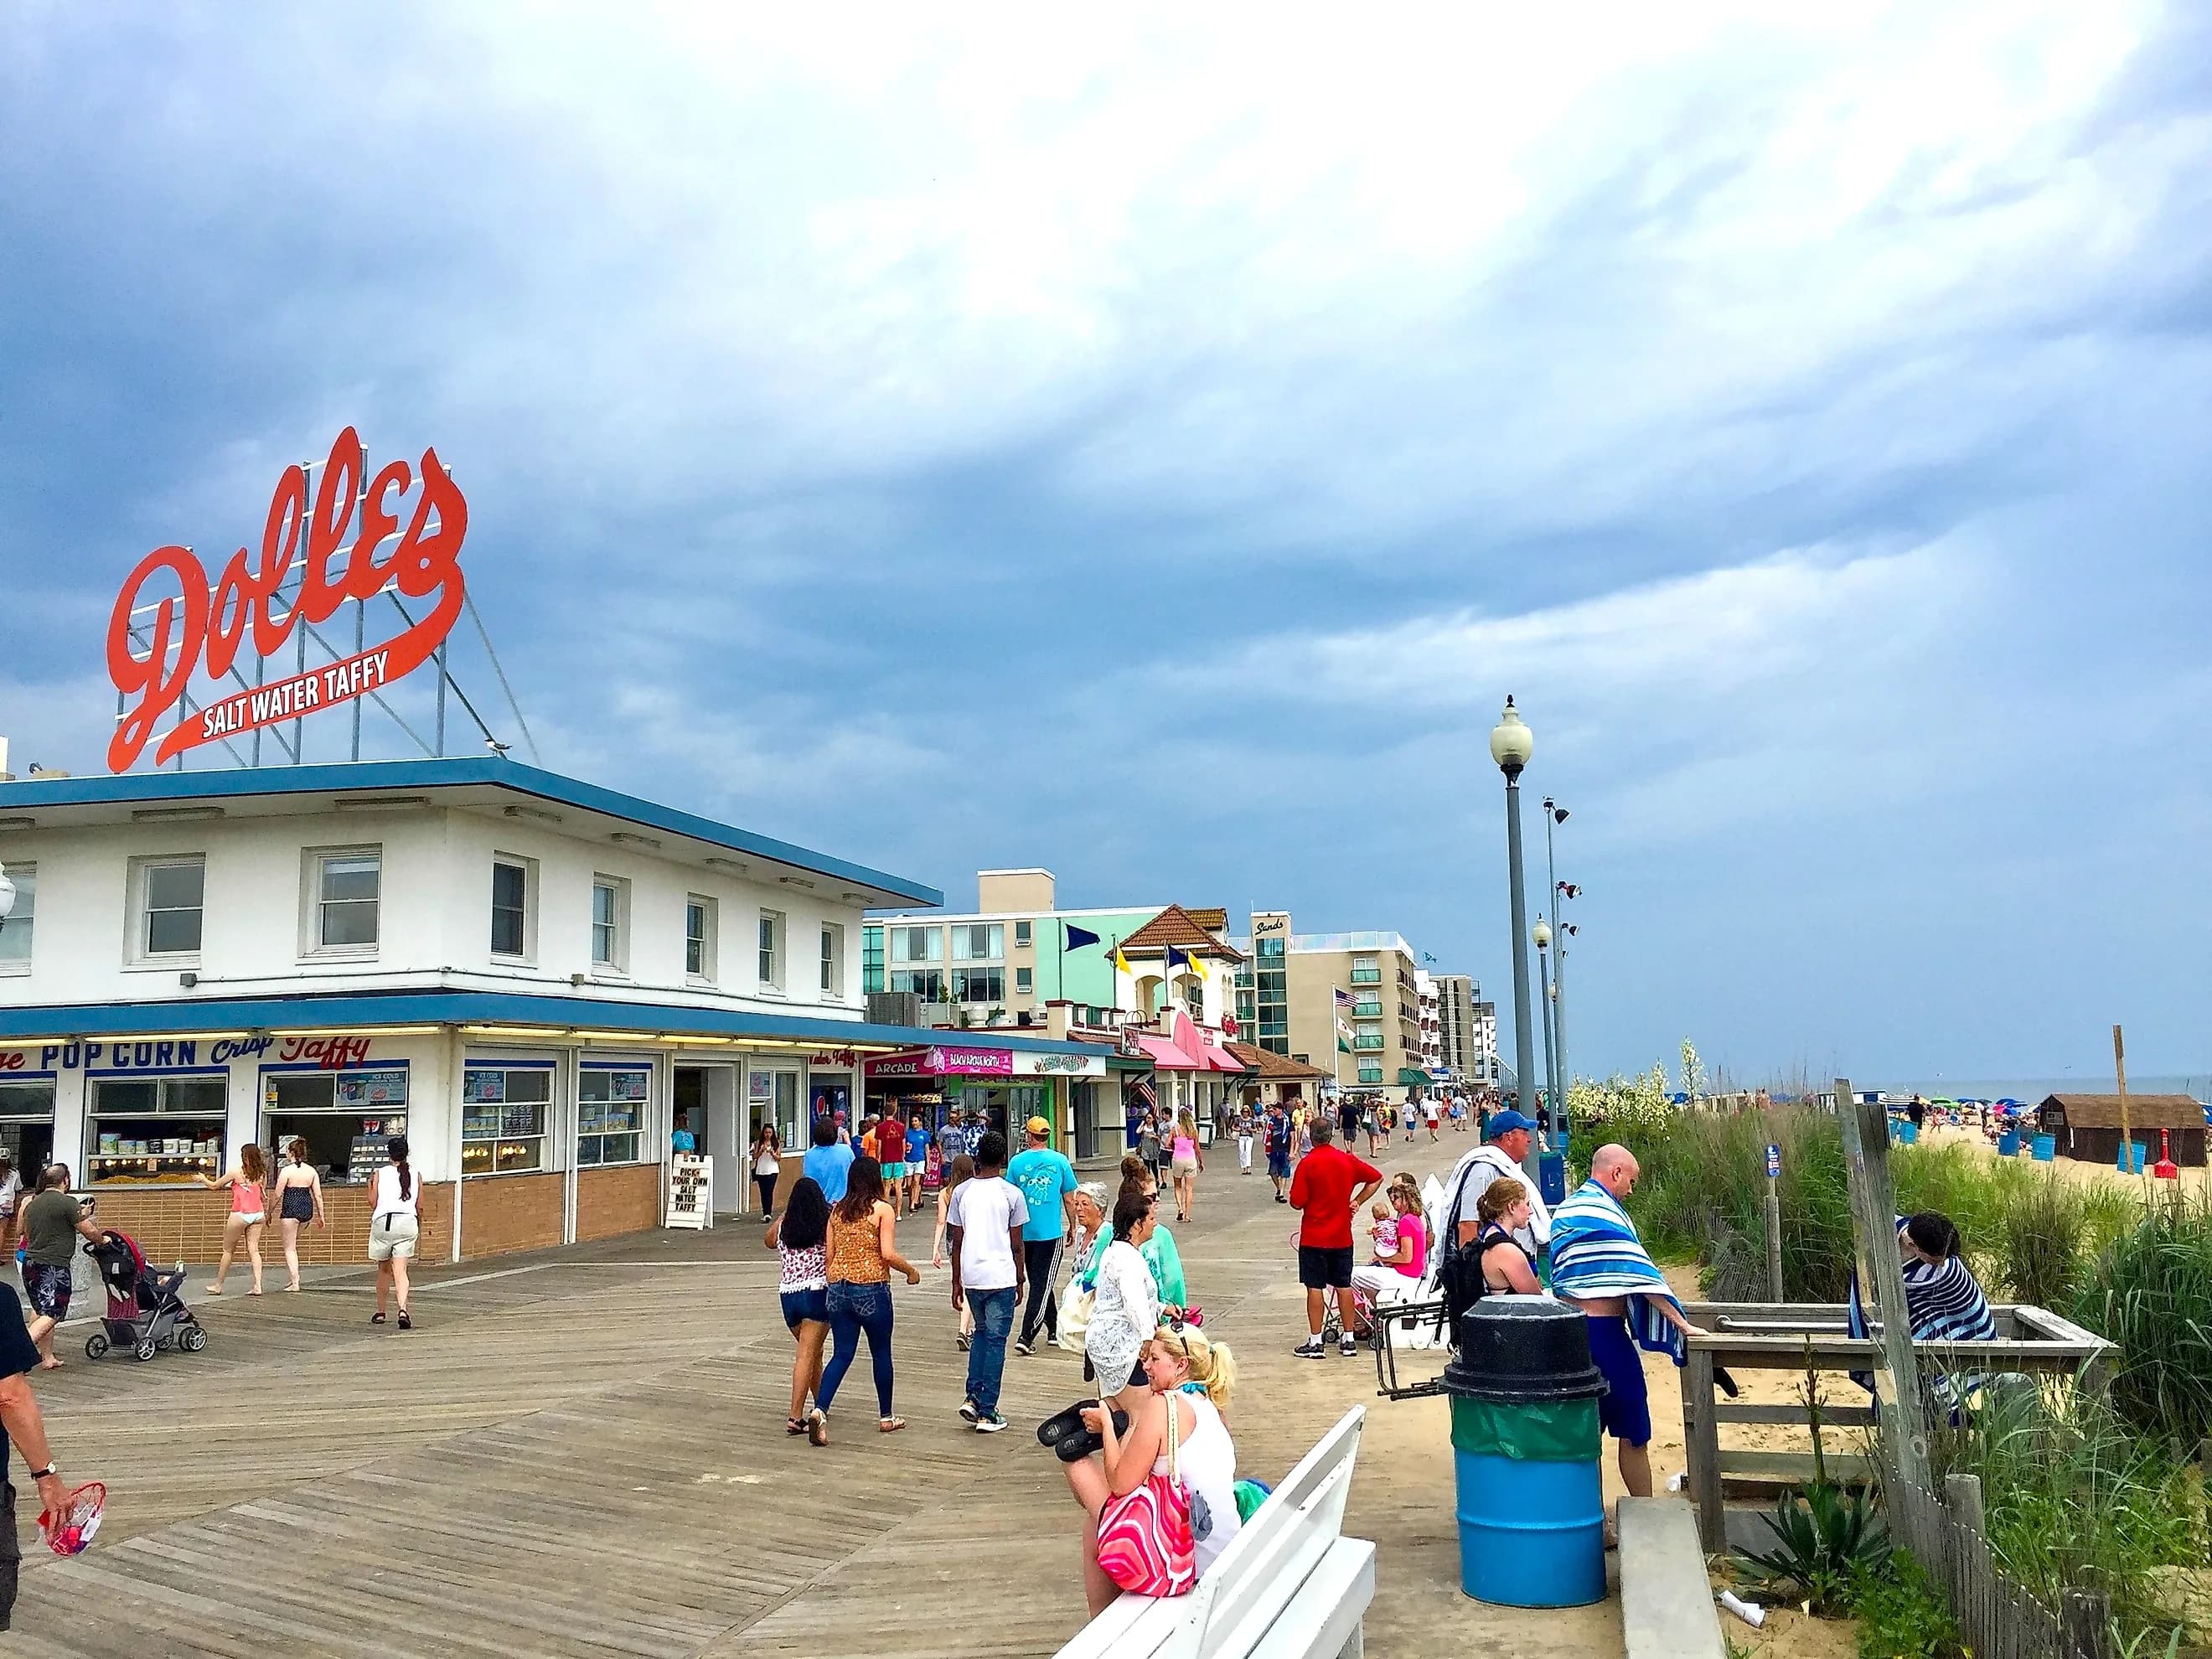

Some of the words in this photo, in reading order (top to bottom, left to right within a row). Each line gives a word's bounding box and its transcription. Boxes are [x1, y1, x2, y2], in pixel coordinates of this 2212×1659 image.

[202, 696, 248, 739] SALT
[251, 675, 320, 725] WATER
[323, 649, 390, 702] TAFFY
[1254, 918, 1284, 935] Sands
[41, 1041, 102, 1069] POP
[112, 1040, 197, 1067] CORN
[279, 1035, 371, 1070] Taffy
[875, 1062, 918, 1073] ARCADE
[672, 1176, 690, 1186] YOUR
[693, 1177, 708, 1186] OWN
[680, 1186, 697, 1194] SALT
[675, 1194, 696, 1203] WATER
[675, 1203, 696, 1212] TAFFY
